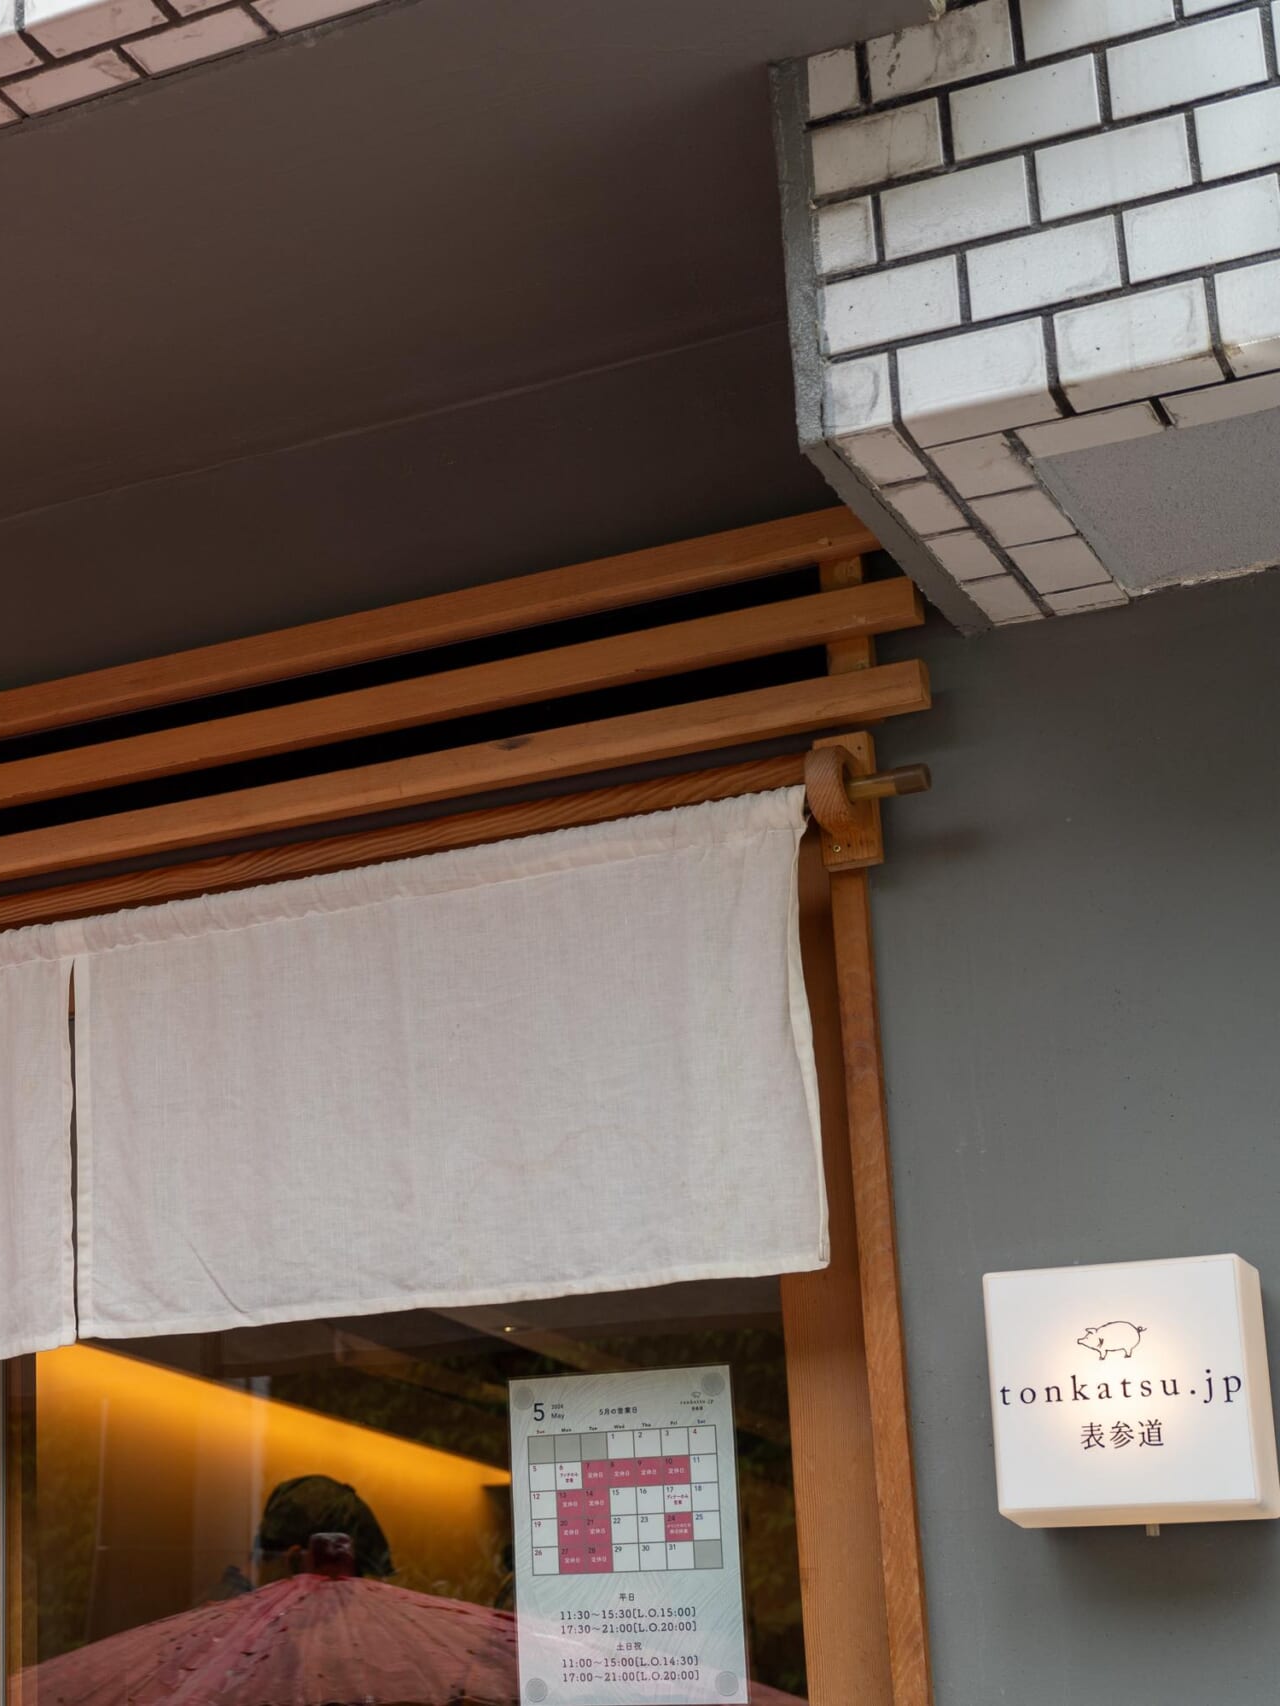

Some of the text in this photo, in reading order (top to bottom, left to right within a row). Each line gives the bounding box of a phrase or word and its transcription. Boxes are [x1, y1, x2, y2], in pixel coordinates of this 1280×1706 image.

[999, 1369, 1242, 1405] tonkatsu.jp
[533, 1402, 545, 1421] 5
[599, 1406, 638, 1416] 5月の営業日
[1080, 1419, 1164, 1450] 表参道
[619, 1592, 635, 1602] 平日
[616, 1642, 642, 1651] 土日祝
